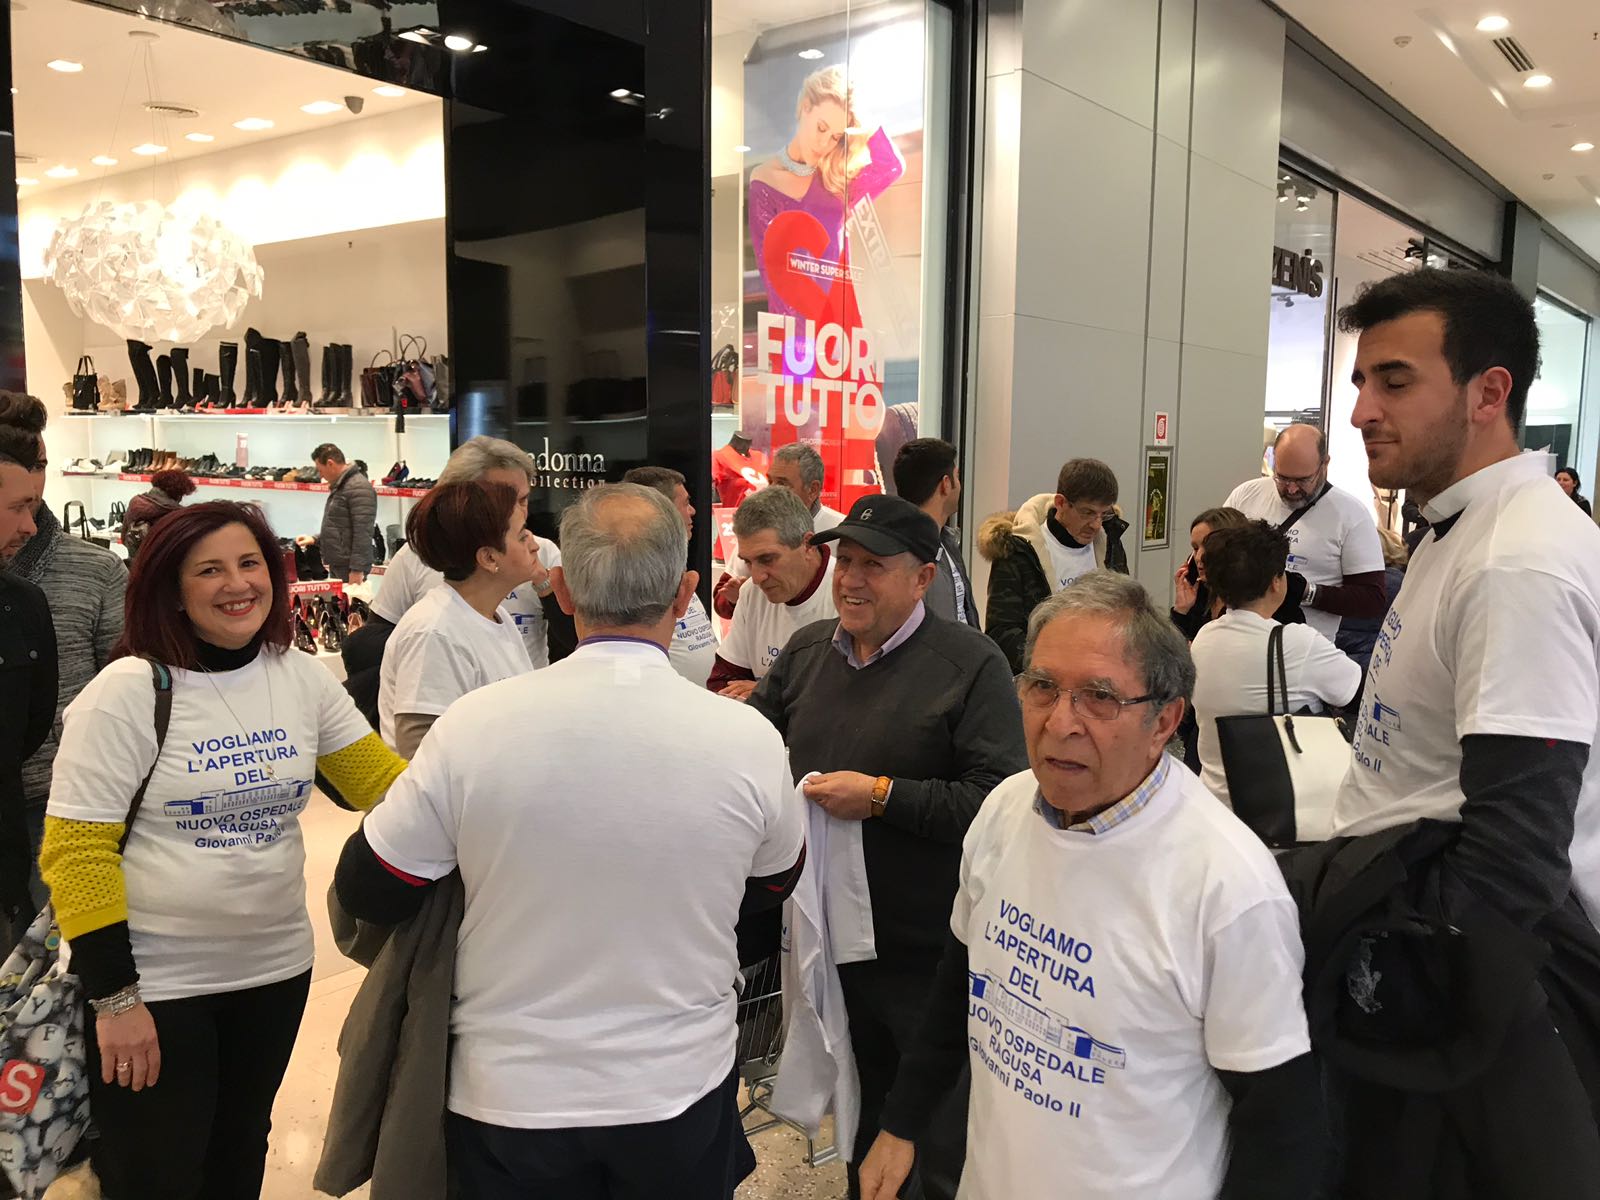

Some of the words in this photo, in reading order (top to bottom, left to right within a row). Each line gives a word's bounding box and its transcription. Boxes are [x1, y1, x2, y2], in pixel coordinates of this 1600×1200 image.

[790, 258, 820, 273] WINTER
[821, 264, 844, 278] SUPER
[757, 311, 885, 383] FUORI
[758, 373, 886, 430] TUTTO
[307, 583, 331, 592] TUTTO
[191, 728, 287, 754] VOGLIAMO
[187, 745, 299, 773] L'APERTURA
[234, 768, 270, 786] DEL
[176, 813, 236, 831] NUOVO
[218, 818, 278, 834] RAGUSA
[240, 799, 304, 821] OSPEDALE
[194, 834, 253, 849] Giovanni
[1000, 899, 1093, 963] VOGLIAMO
[985, 921, 1096, 998] L'APERTURA
[1009, 966, 1042, 1001] DEL
[968, 1003, 1002, 1035] UOVO
[969, 1036, 1010, 1087] Giovanni
[989, 1034, 1042, 1085] RAGUSA
[1005, 1029, 1106, 1084] OSPEDALE
[1014, 1078, 1063, 1112] Paolo
[1069, 1102, 1081, 1118] II
